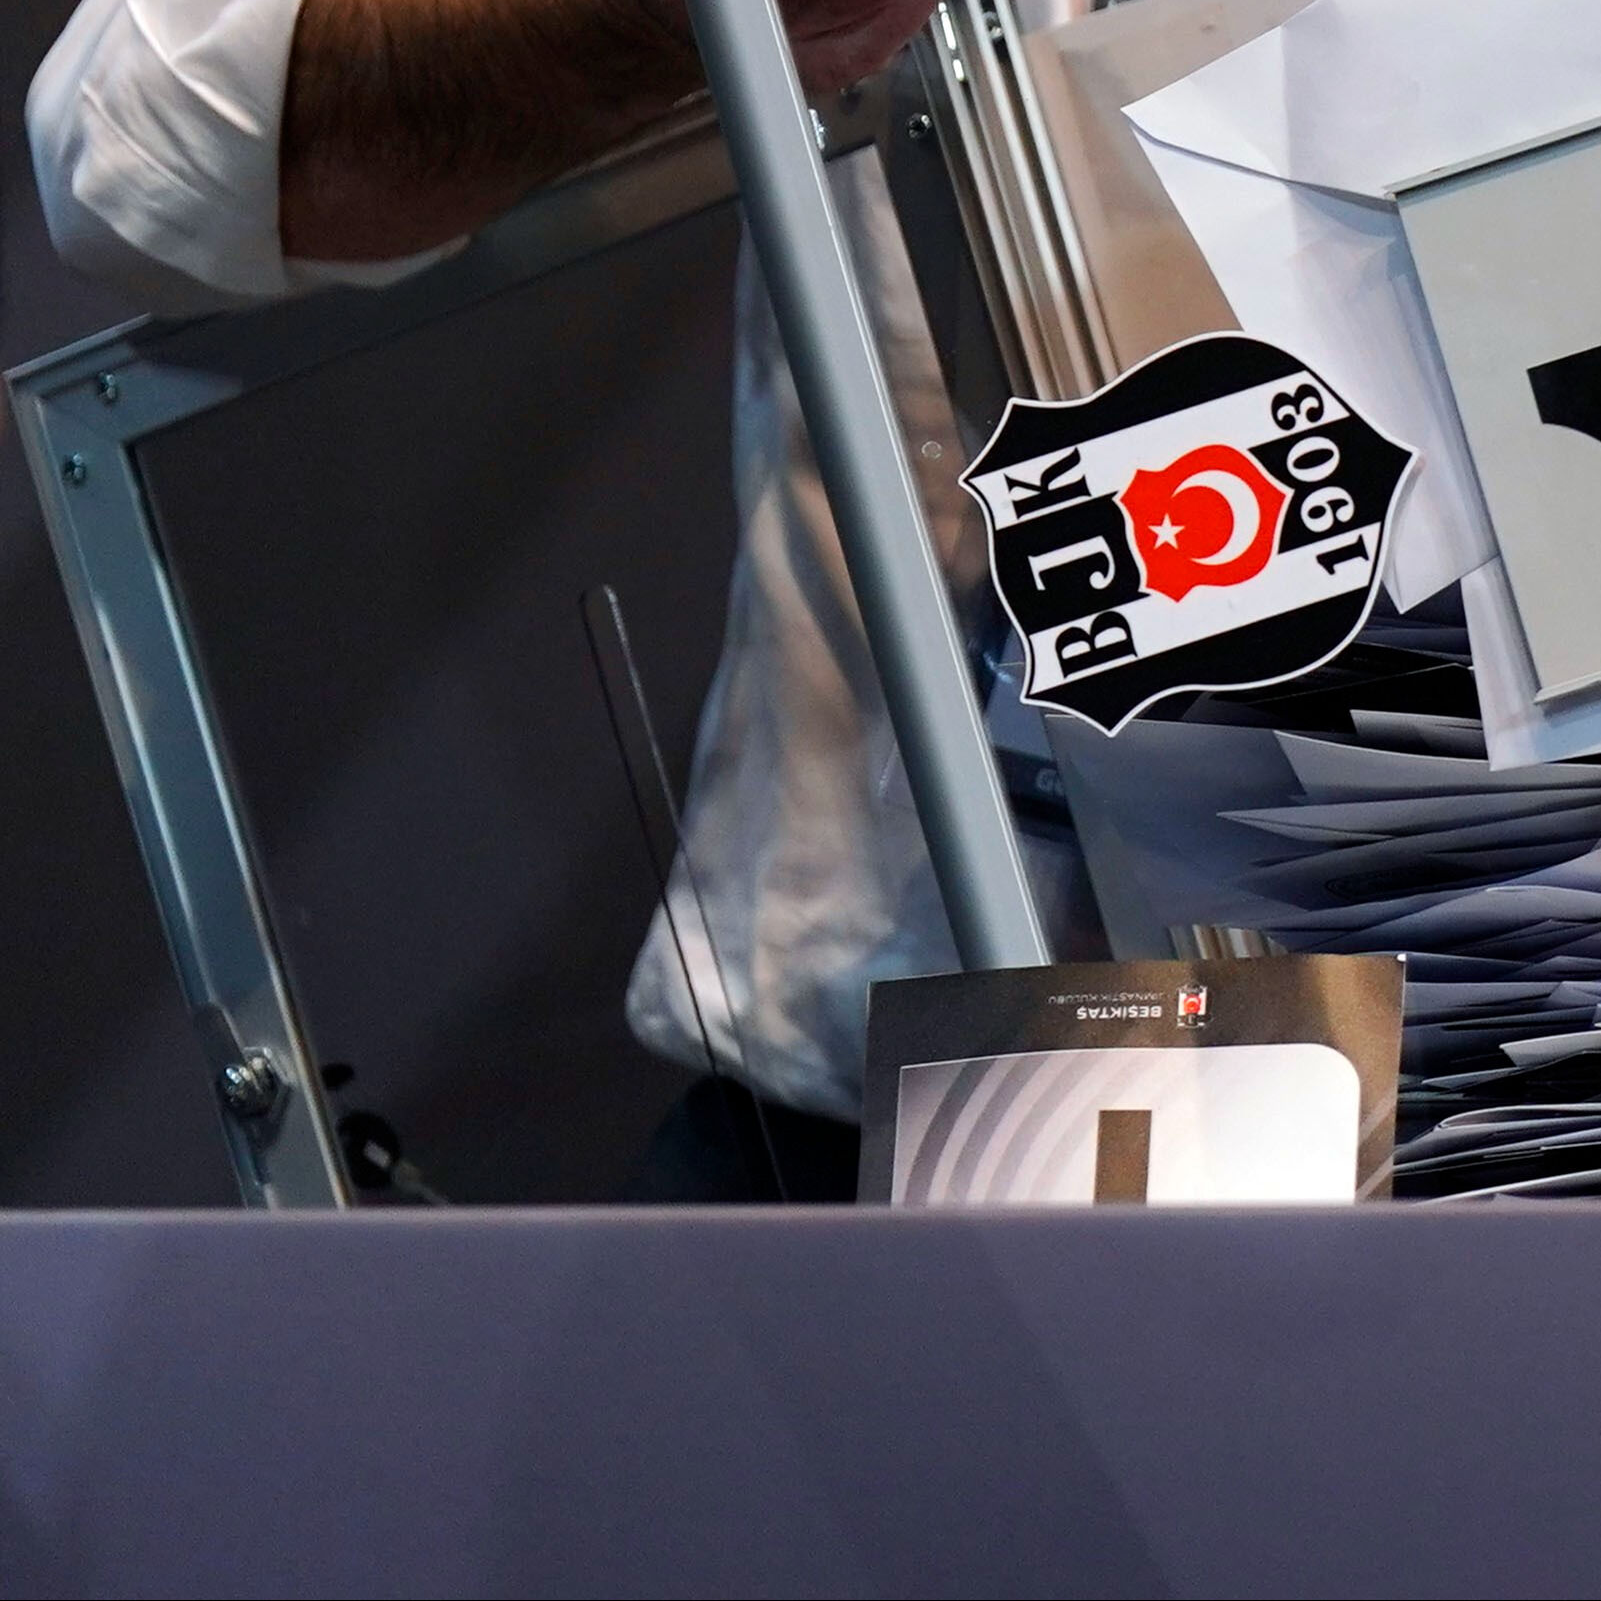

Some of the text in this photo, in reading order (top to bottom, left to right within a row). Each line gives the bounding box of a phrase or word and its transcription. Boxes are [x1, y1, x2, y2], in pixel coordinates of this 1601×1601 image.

[1002, 447, 1139, 680] BJK
[1270, 382, 1371, 577] 1903
[1076, 1005, 1163, 1020] BEŞİKTAŞ
